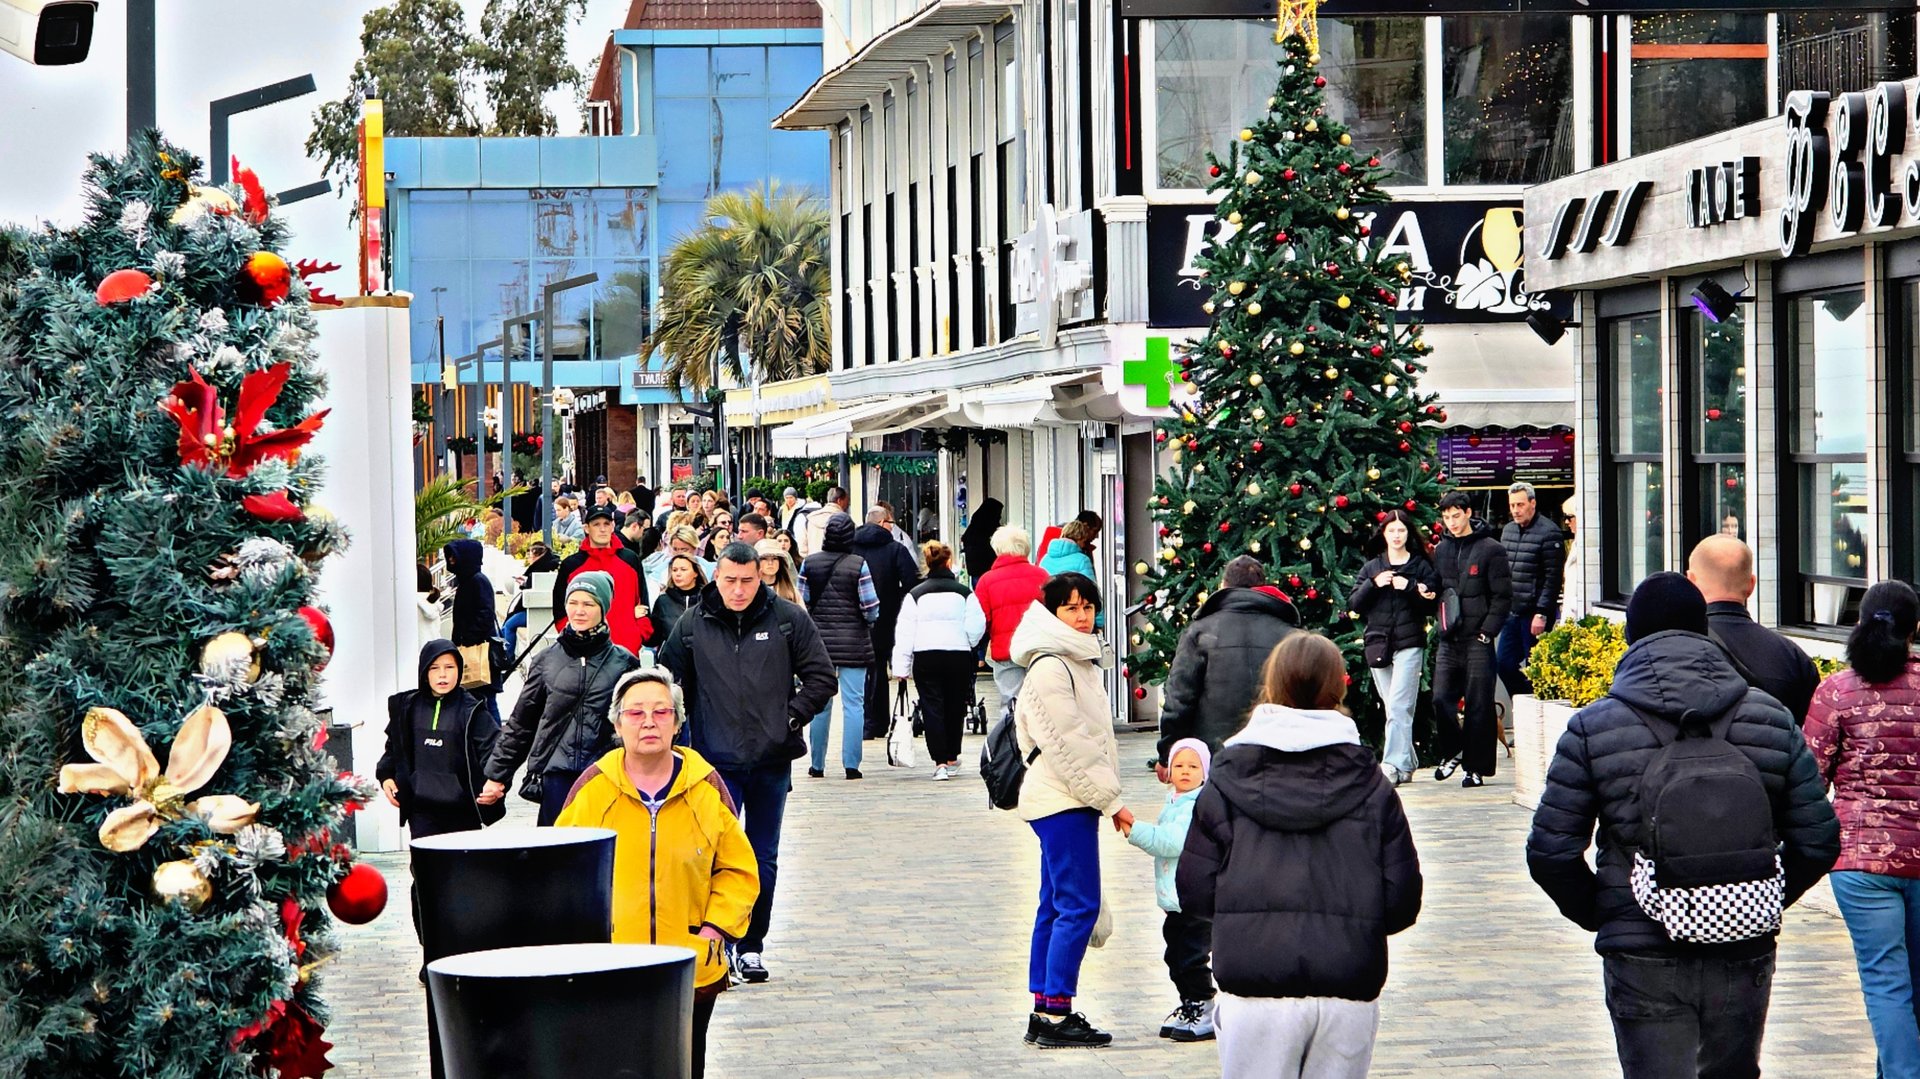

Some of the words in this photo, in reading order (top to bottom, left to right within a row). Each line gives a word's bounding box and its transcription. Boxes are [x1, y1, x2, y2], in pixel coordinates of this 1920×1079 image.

[1686, 156, 1755, 229] КАФЕ
[1780, 80, 1920, 258] ФЕС
[639, 373, 671, 385] ТУАЛЕ
[424, 738, 443, 747] FILA
